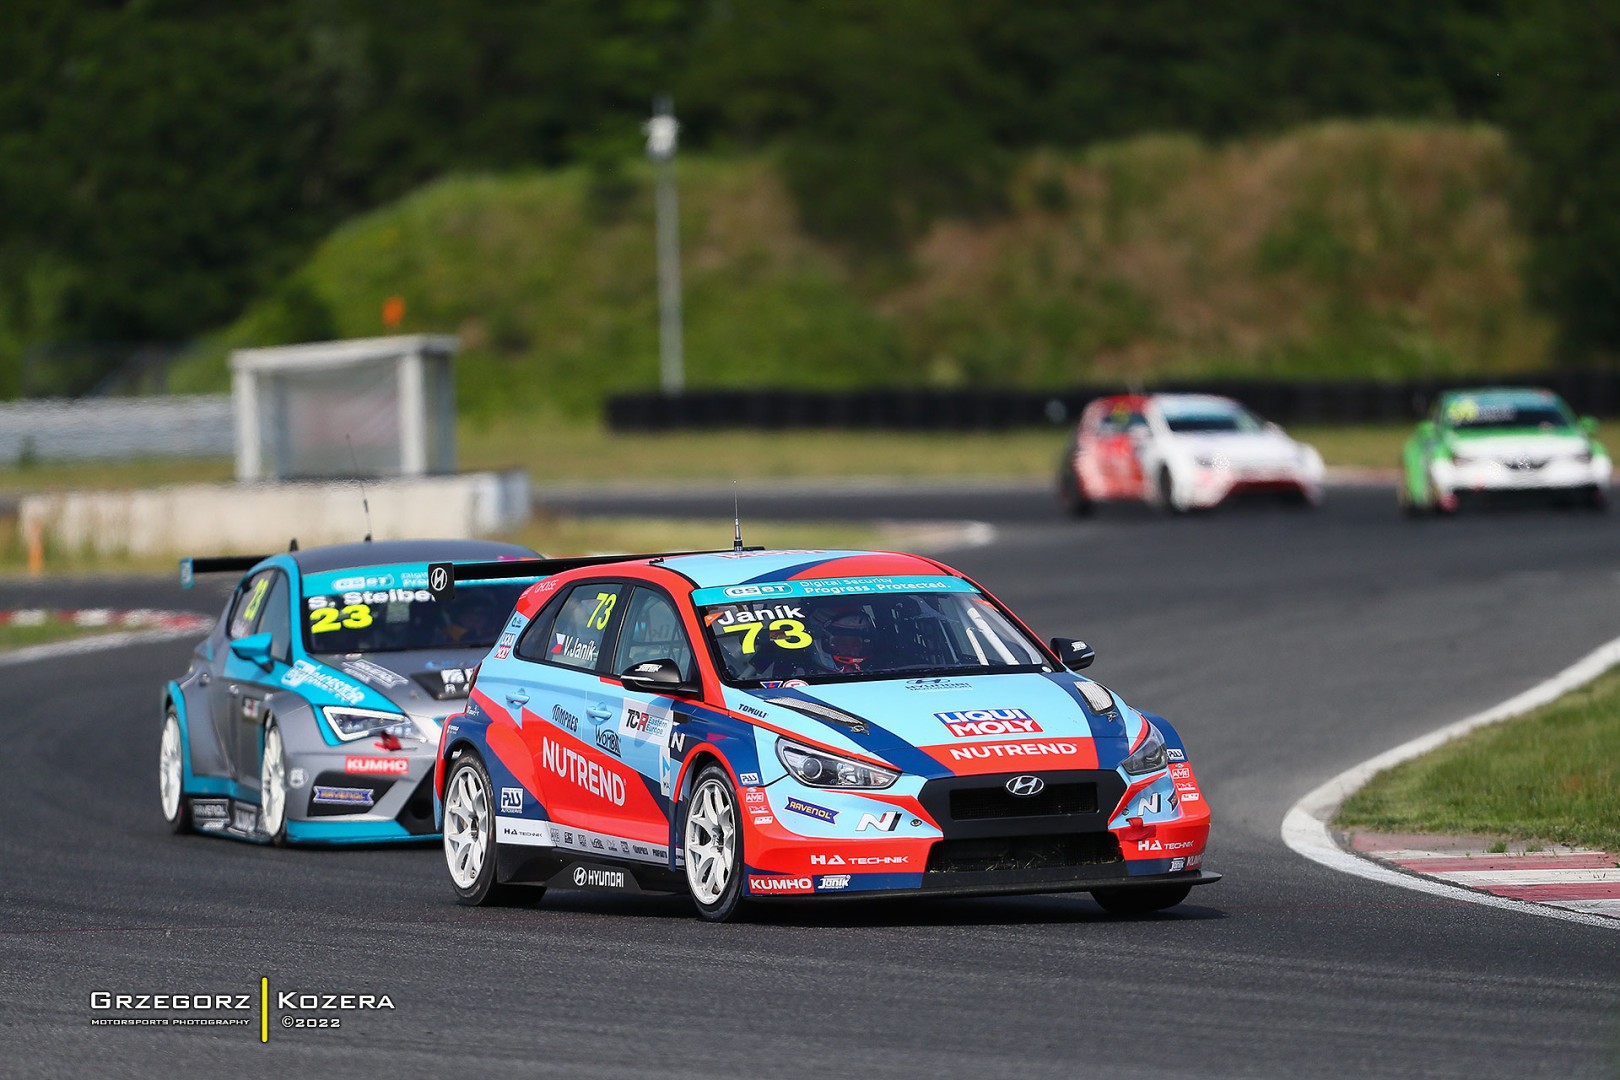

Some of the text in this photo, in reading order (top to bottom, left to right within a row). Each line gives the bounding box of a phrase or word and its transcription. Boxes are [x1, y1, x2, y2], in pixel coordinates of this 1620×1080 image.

[800, 577, 892, 588] Digital Security
[805, 580, 951, 594] Progress. Protected.
[343, 589, 436, 605] Steibe
[309, 604, 374, 634] 23
[586, 592, 617, 631] 73
[717, 605, 806, 625] Janík
[723, 619, 813, 655] 73
[552, 704, 579, 733] TOMPRES
[739, 703, 768, 718] TOMULI
[937, 708, 1027, 724] LIQUI
[626, 708, 650, 732] TCR
[949, 720, 1034, 737] MOLY
[949, 743, 1077, 760] NUTREND
[347, 759, 408, 772] KUMHO
[541, 735, 627, 807] NUTREND
[789, 801, 830, 819] RAVENOL
[810, 854, 909, 865] HA TECHNIK
[588, 870, 625, 888] HYUNDAI
[750, 877, 812, 890] KUMHO
